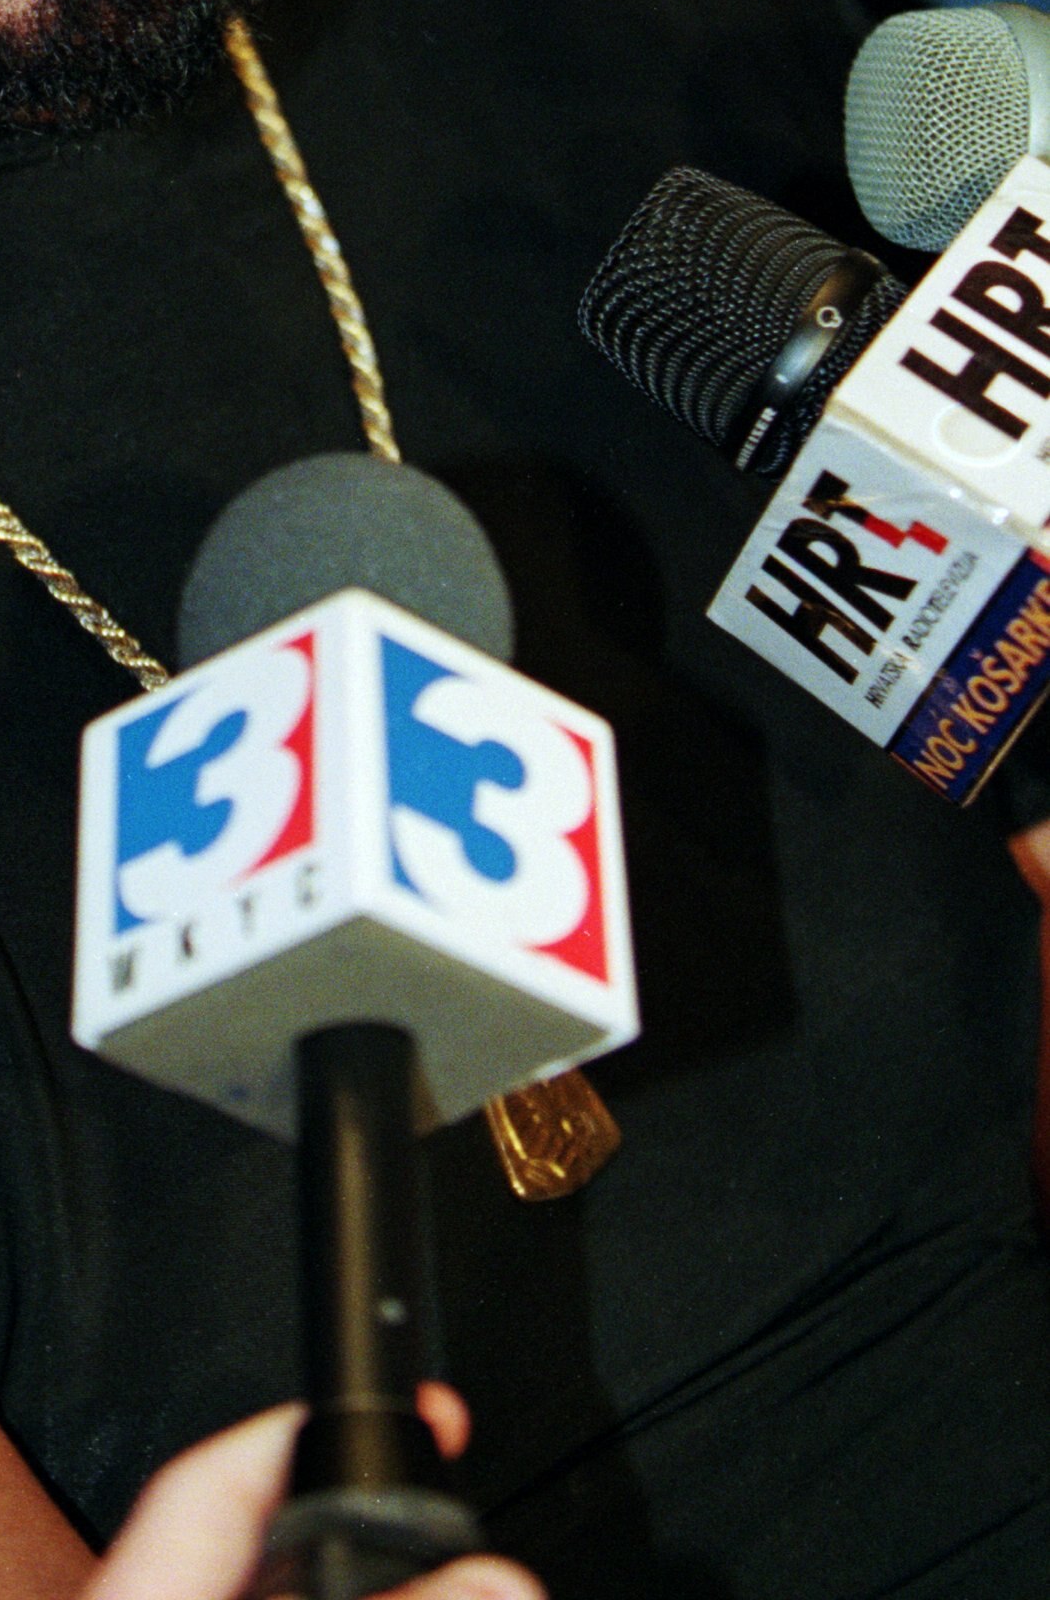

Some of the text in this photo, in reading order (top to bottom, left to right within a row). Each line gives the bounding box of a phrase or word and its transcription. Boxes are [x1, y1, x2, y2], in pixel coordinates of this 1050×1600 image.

[898, 206, 1050, 441] HRT
[744, 470, 948, 686] HRT
[119, 640, 312, 924] 3
[393, 670, 595, 958] 3
